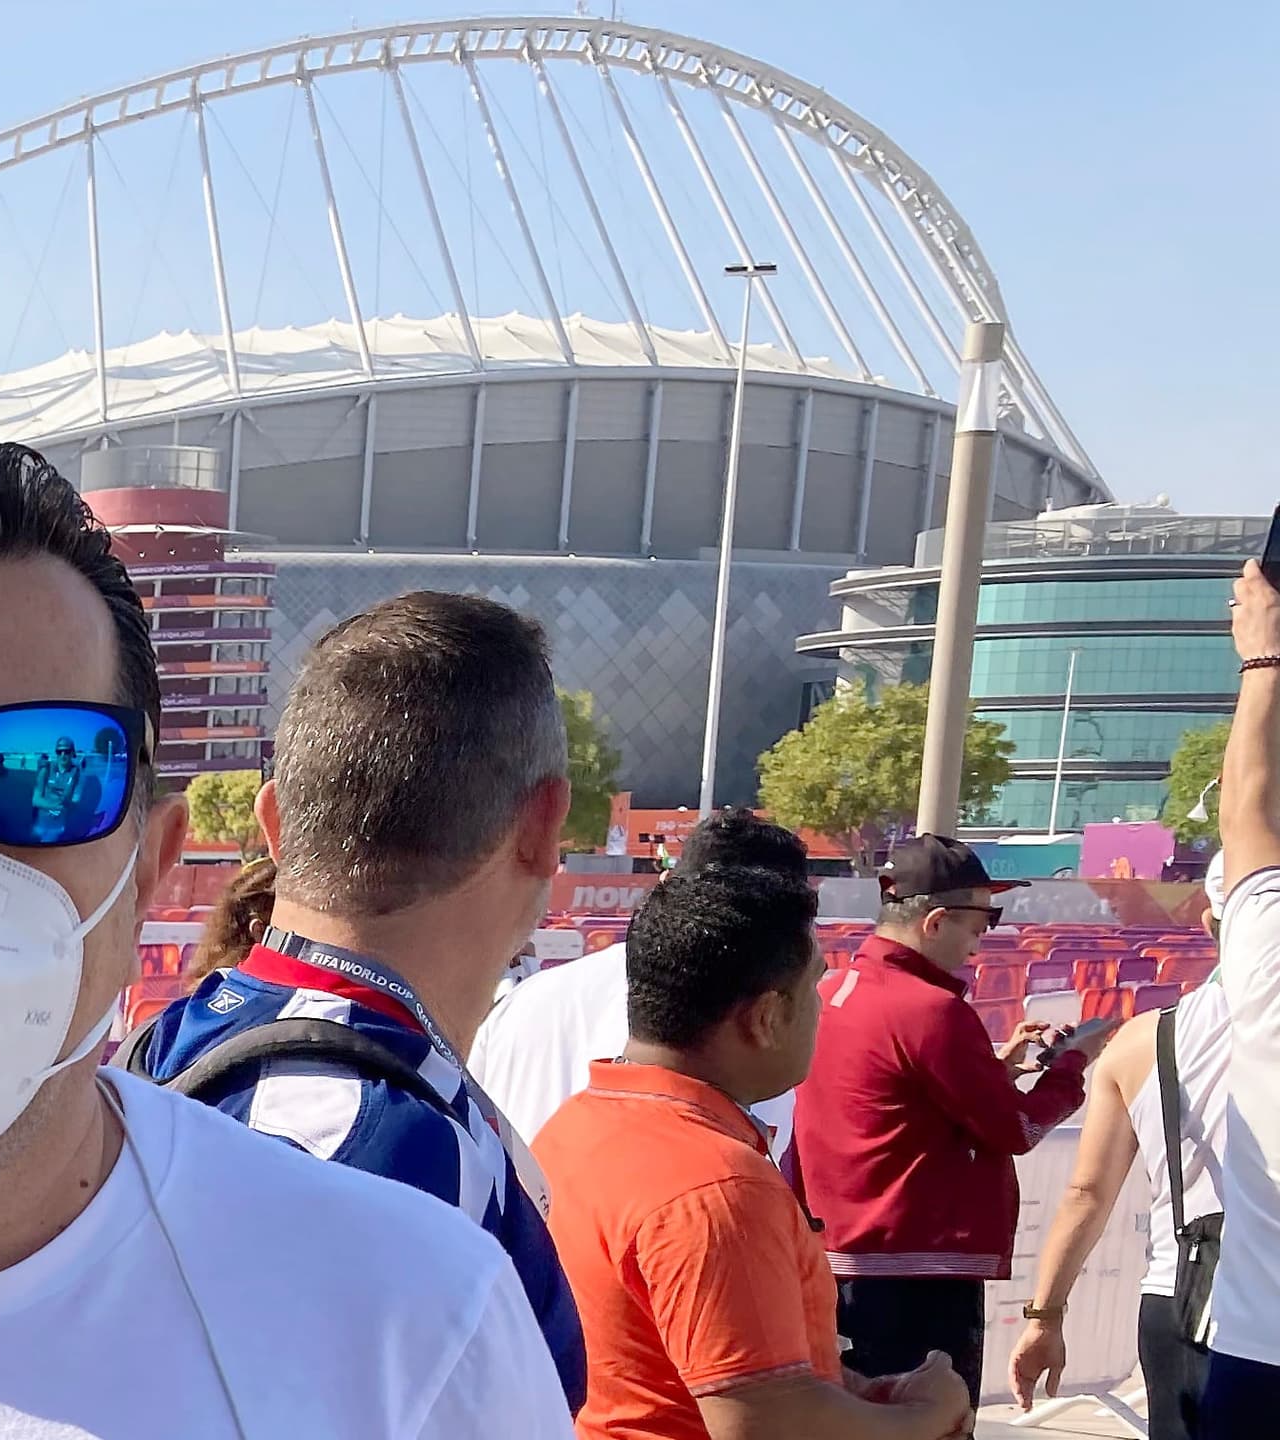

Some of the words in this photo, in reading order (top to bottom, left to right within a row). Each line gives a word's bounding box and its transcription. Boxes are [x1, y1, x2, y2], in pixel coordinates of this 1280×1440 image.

[311, 951, 338, 969] FIFA
[340, 959, 387, 986] WORLD
[388, 982, 414, 1000] CUP
